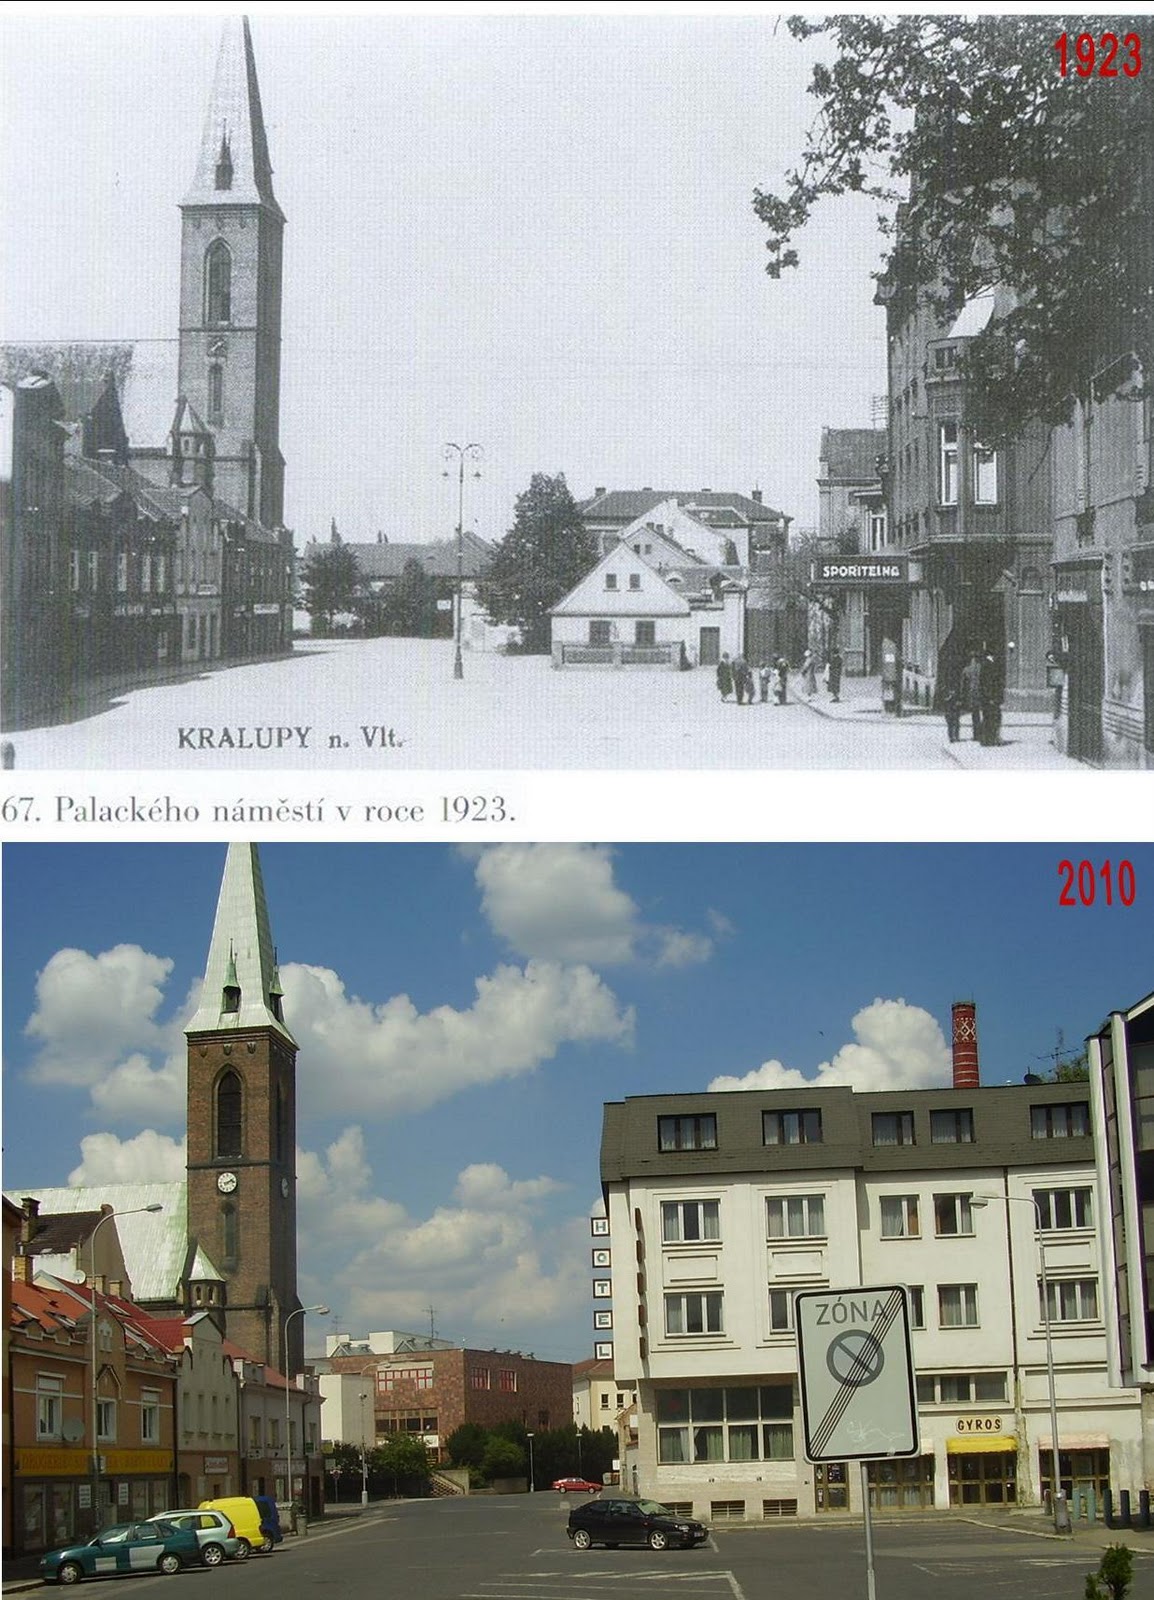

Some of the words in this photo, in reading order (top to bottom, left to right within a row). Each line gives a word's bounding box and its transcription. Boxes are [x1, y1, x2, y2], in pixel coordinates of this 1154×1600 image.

[595, 1221, 610, 1357] HOTEL
[815, 1296, 890, 1326] ZÓNA
[957, 1419, 1001, 1431] GYROS
